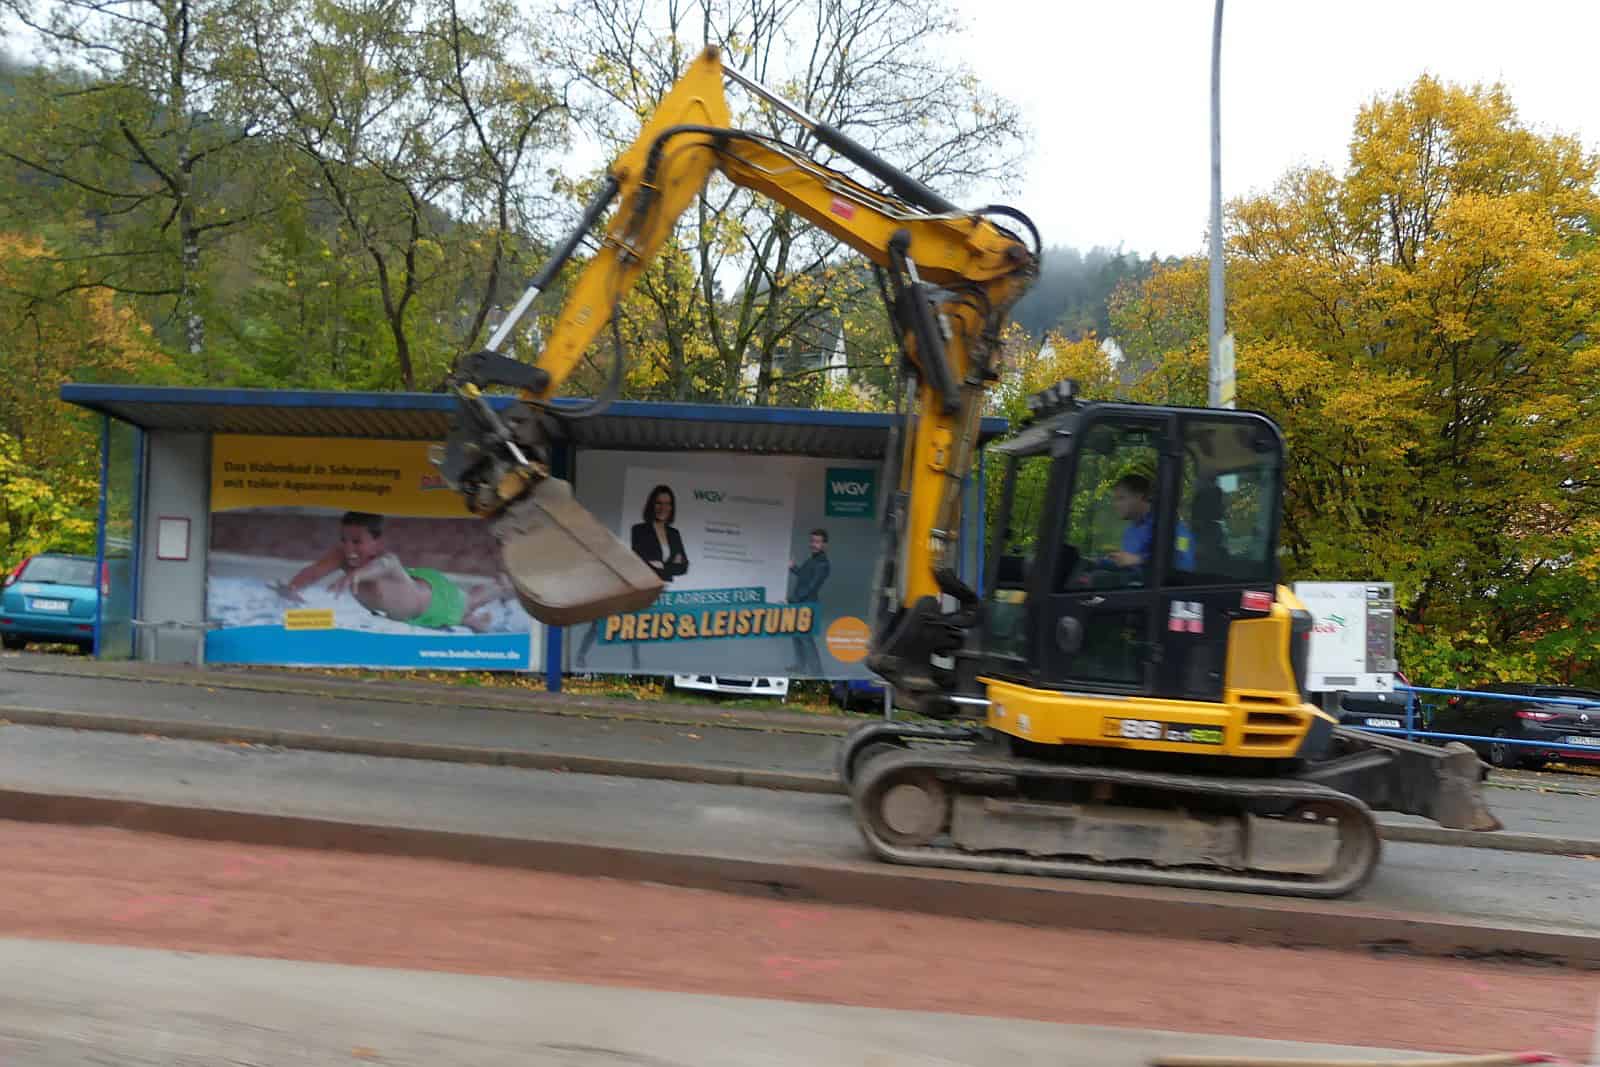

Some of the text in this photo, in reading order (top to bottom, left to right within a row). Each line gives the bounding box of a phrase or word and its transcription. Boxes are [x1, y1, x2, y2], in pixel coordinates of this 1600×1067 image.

[831, 481, 869, 495] WGV
[694, 489, 727, 502] WGV
[674, 592, 731, 605] ADRESSE
[604, 613, 676, 641] PREIS
[700, 607, 814, 637] LEISTUNG
